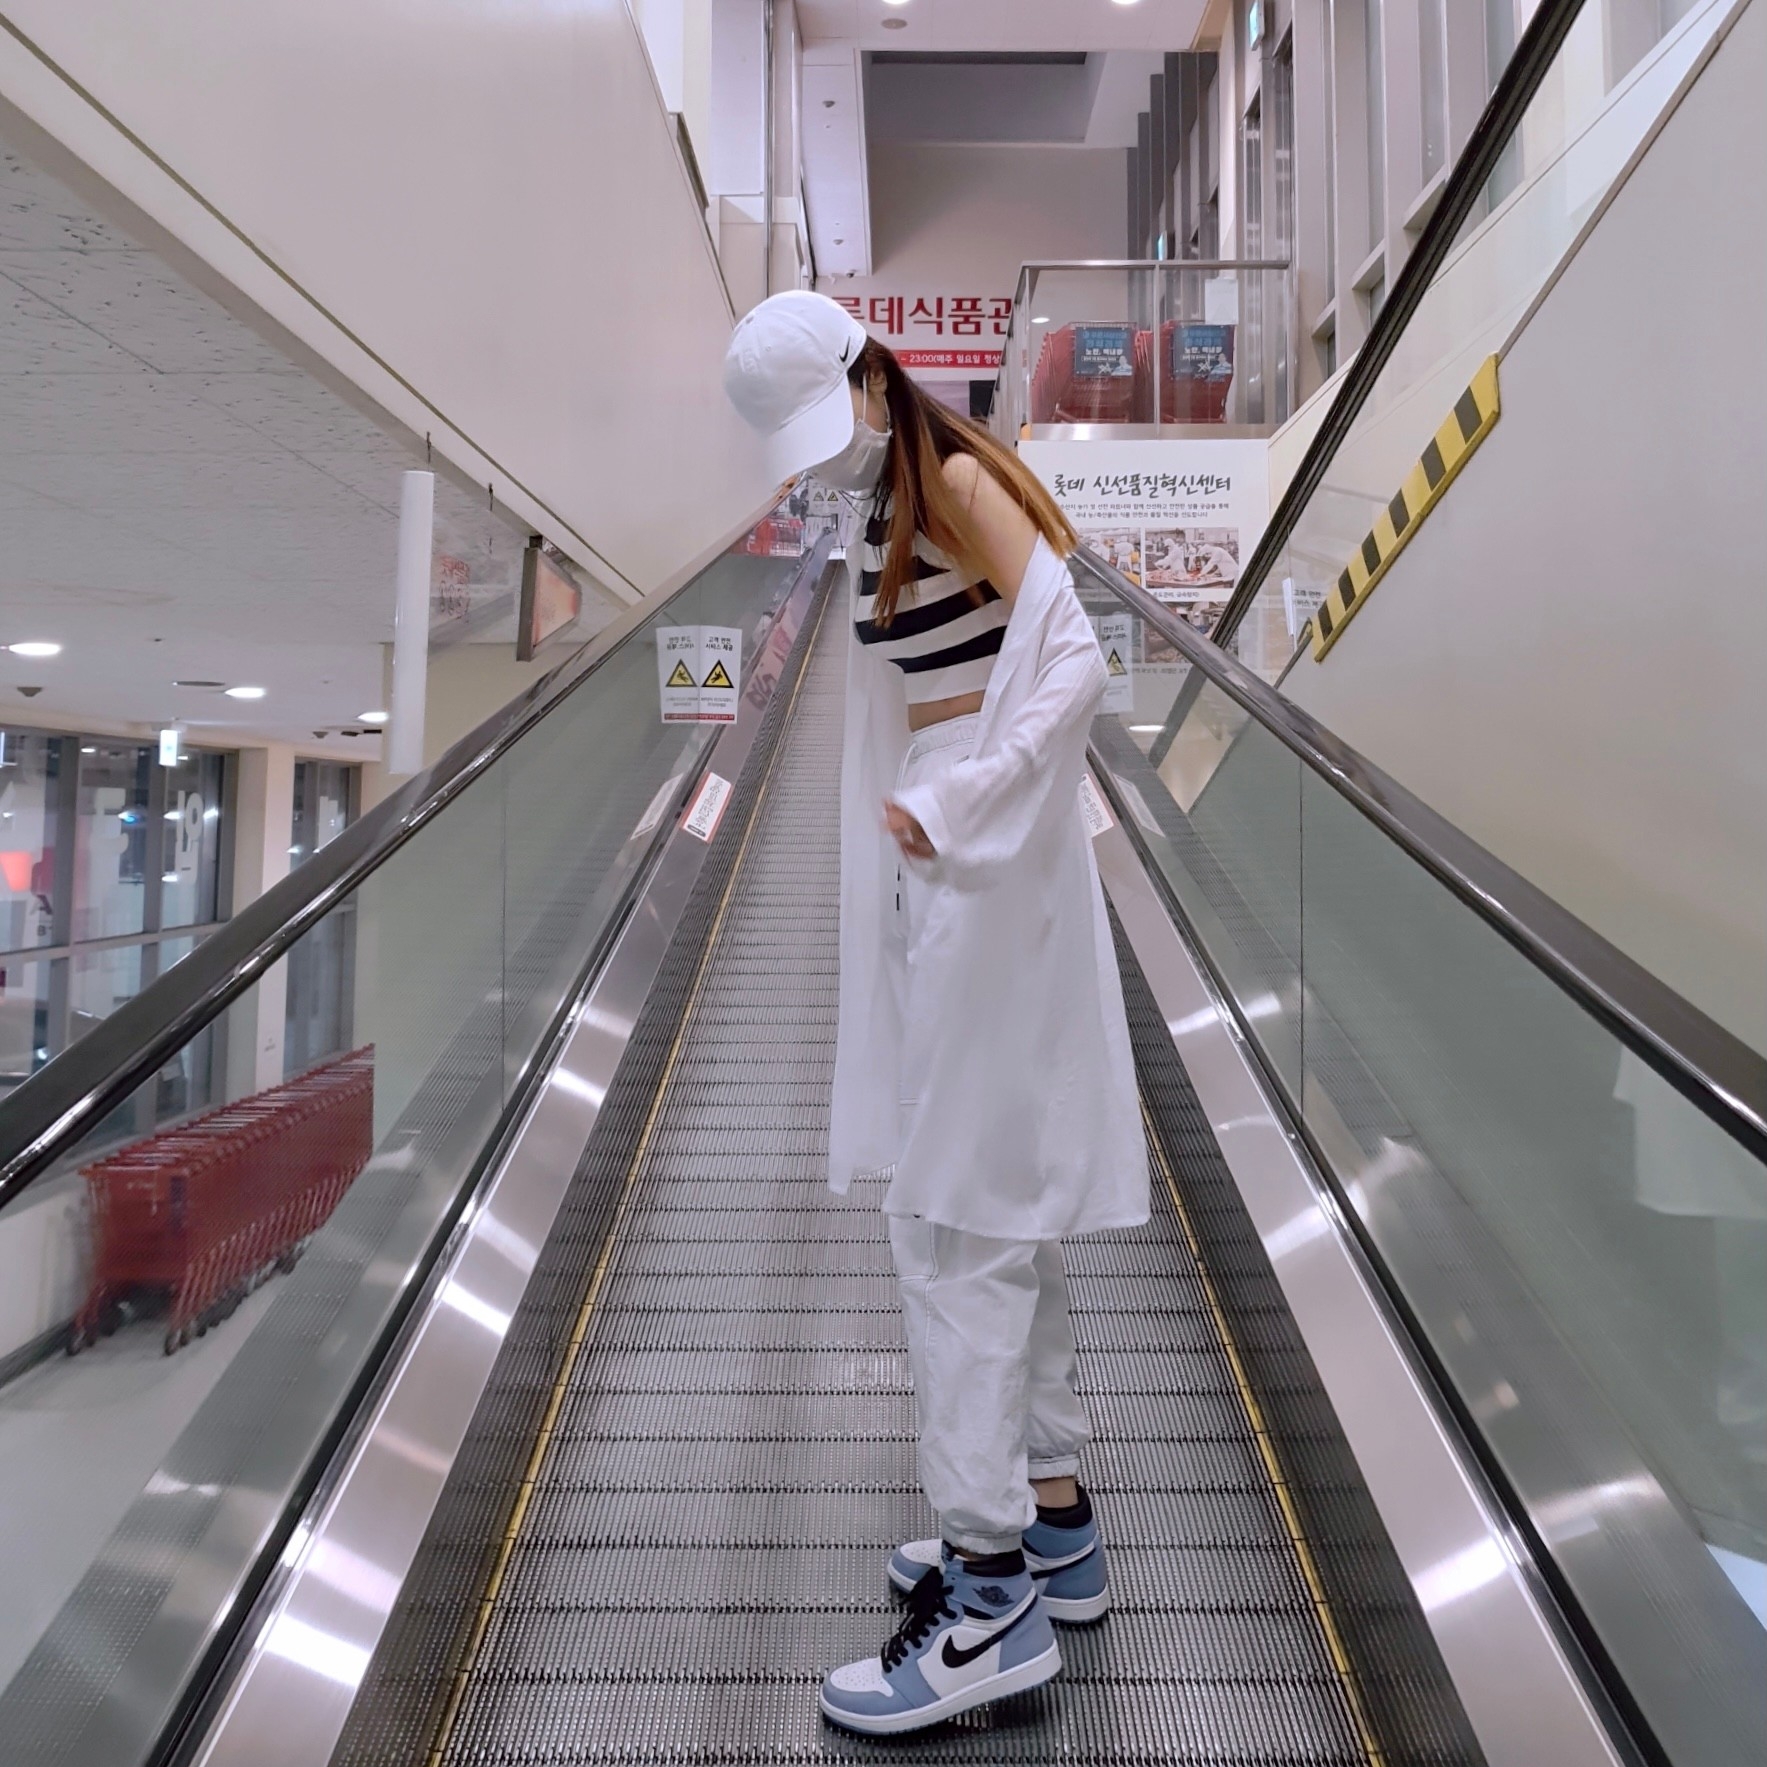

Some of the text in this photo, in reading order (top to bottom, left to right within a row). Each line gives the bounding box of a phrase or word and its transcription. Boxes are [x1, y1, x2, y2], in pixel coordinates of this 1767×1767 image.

[956, 354, 980, 364] 일요일
[1054, 473, 1231, 498] 롯데 신선품질혁신센터
